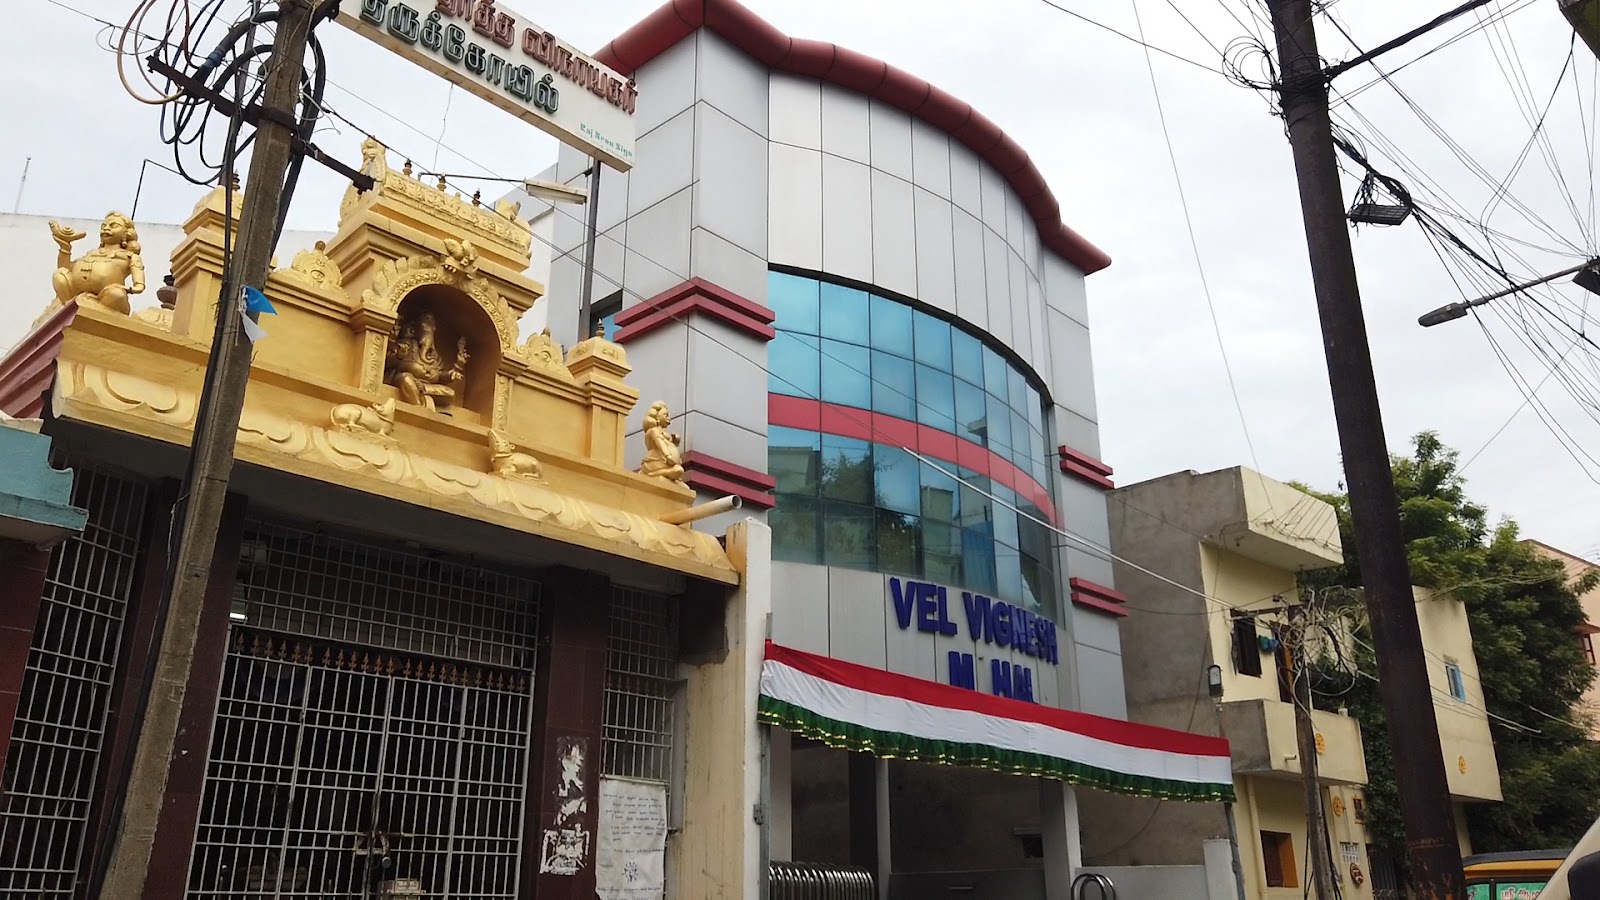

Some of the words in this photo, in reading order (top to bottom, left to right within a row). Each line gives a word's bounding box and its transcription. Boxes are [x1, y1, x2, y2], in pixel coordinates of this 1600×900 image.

[359, 0, 559, 114] தருக்கோயில்
[522, 27, 638, 115] விநாயகர்
[889, 577, 957, 636] VEL
[962, 592, 1058, 665] VIGNESH
